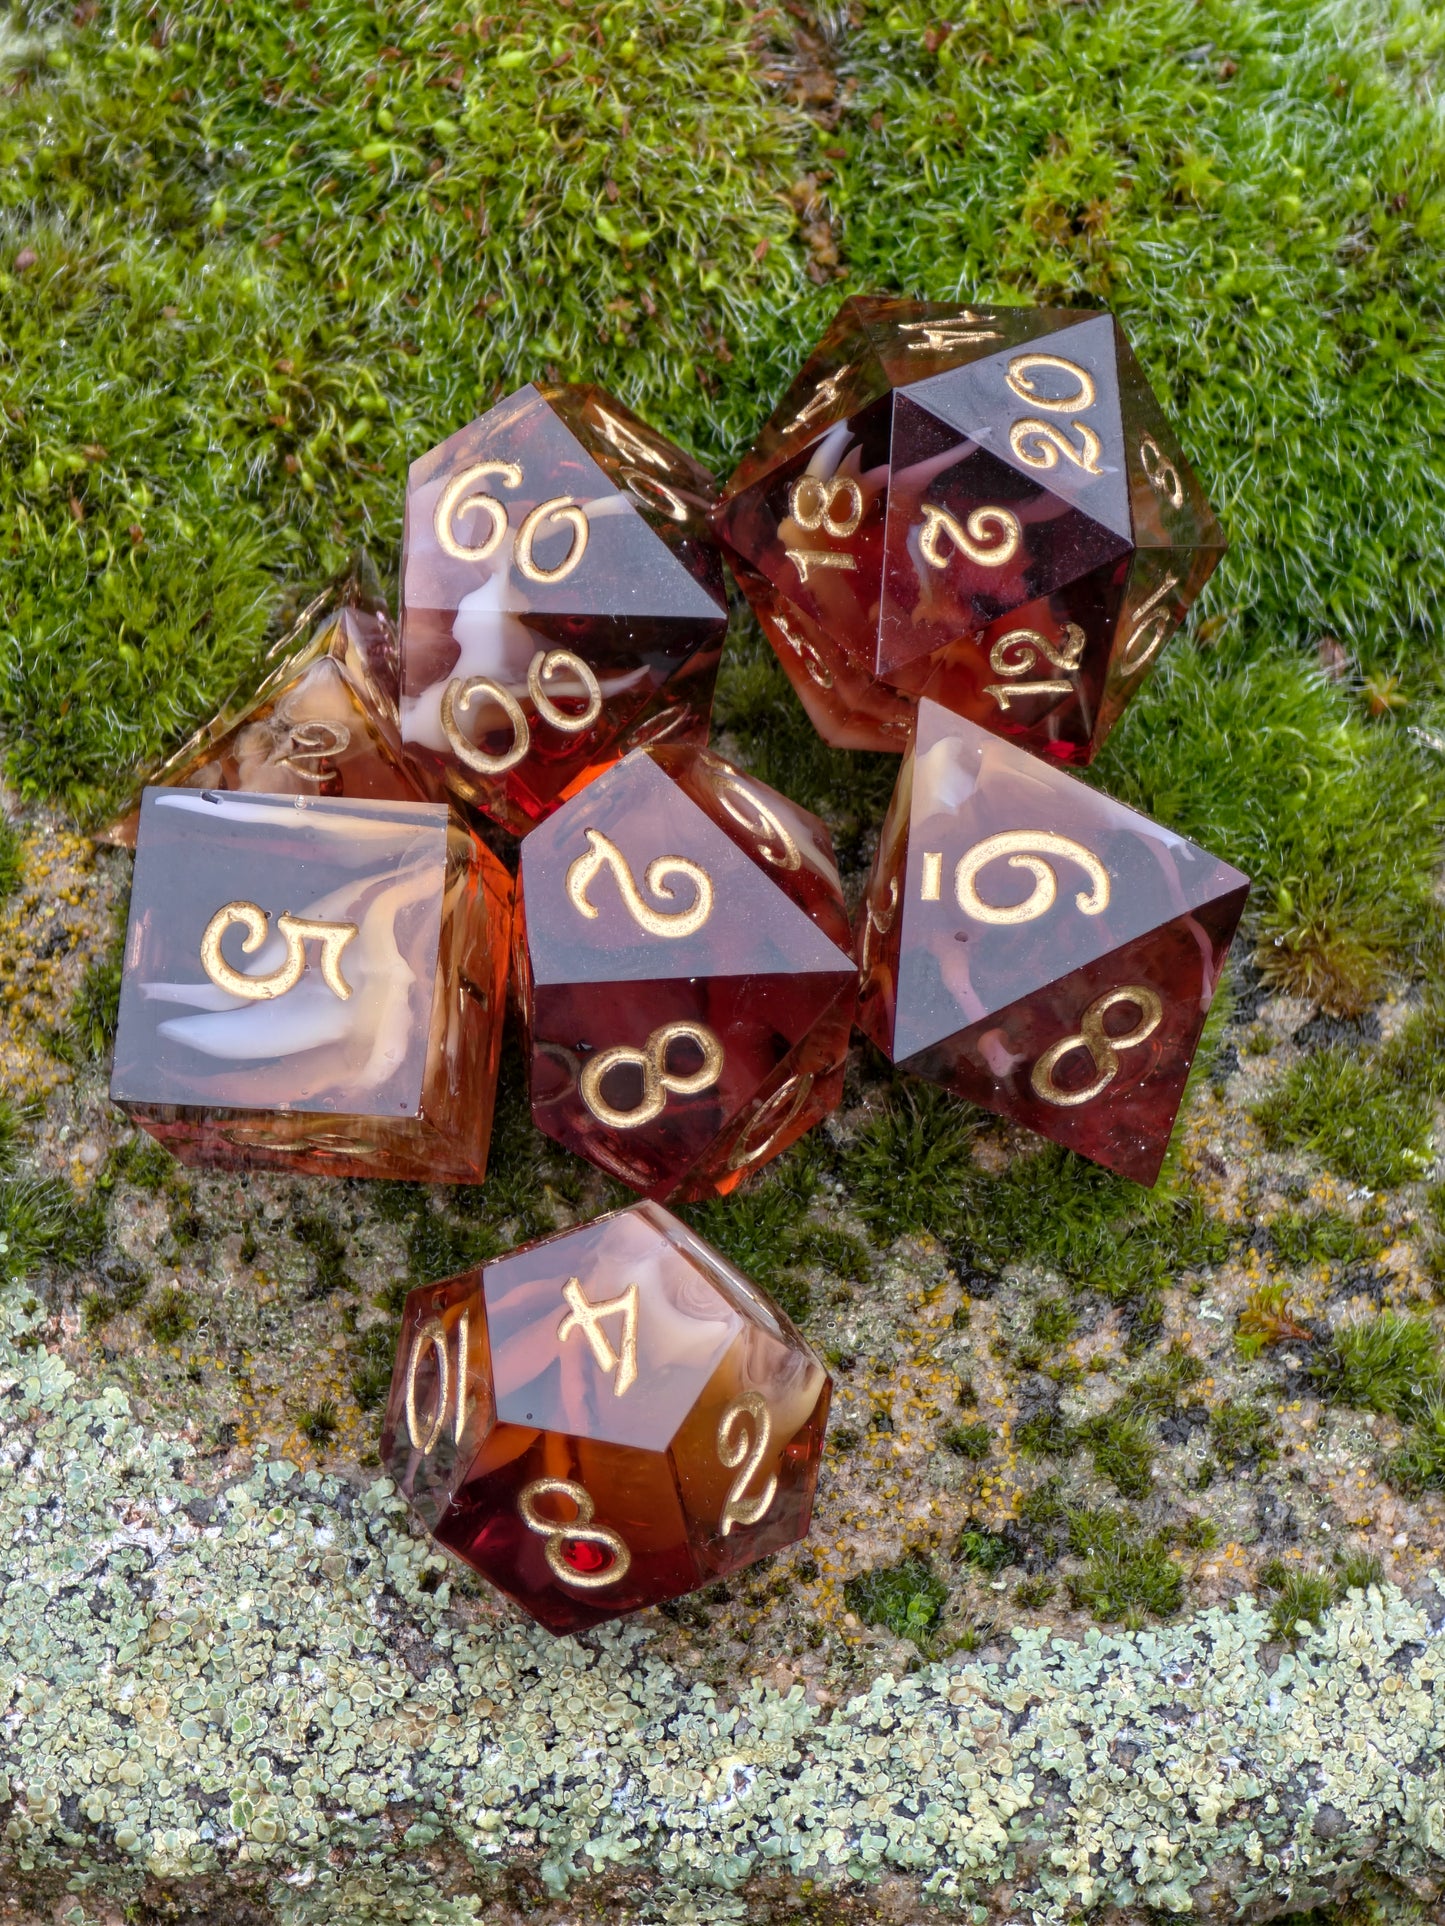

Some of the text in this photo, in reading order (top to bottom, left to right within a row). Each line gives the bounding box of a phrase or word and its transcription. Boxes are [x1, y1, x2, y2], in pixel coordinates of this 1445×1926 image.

[899, 309, 1005, 351] 14
[782, 364, 850, 434] 4
[1005, 352, 1104, 475] 20
[434, 459, 590, 584] 60
[1139, 430, 1184, 509] 8
[785, 474, 864, 583] 18
[917, 503, 1022, 569] 2
[983, 622, 1087, 711] 12
[1121, 570, 1180, 677] 10
[440, 649, 602, 775] 00
[565, 827, 714, 938] 2
[201, 900, 359, 1001] 5
[580, 1020, 725, 1130] 8
[1030, 984, 1163, 1107] 8
[556, 1276, 640, 1397] 4
[717, 1391, 778, 1536] 2
[518, 1477, 631, 1588] 8
